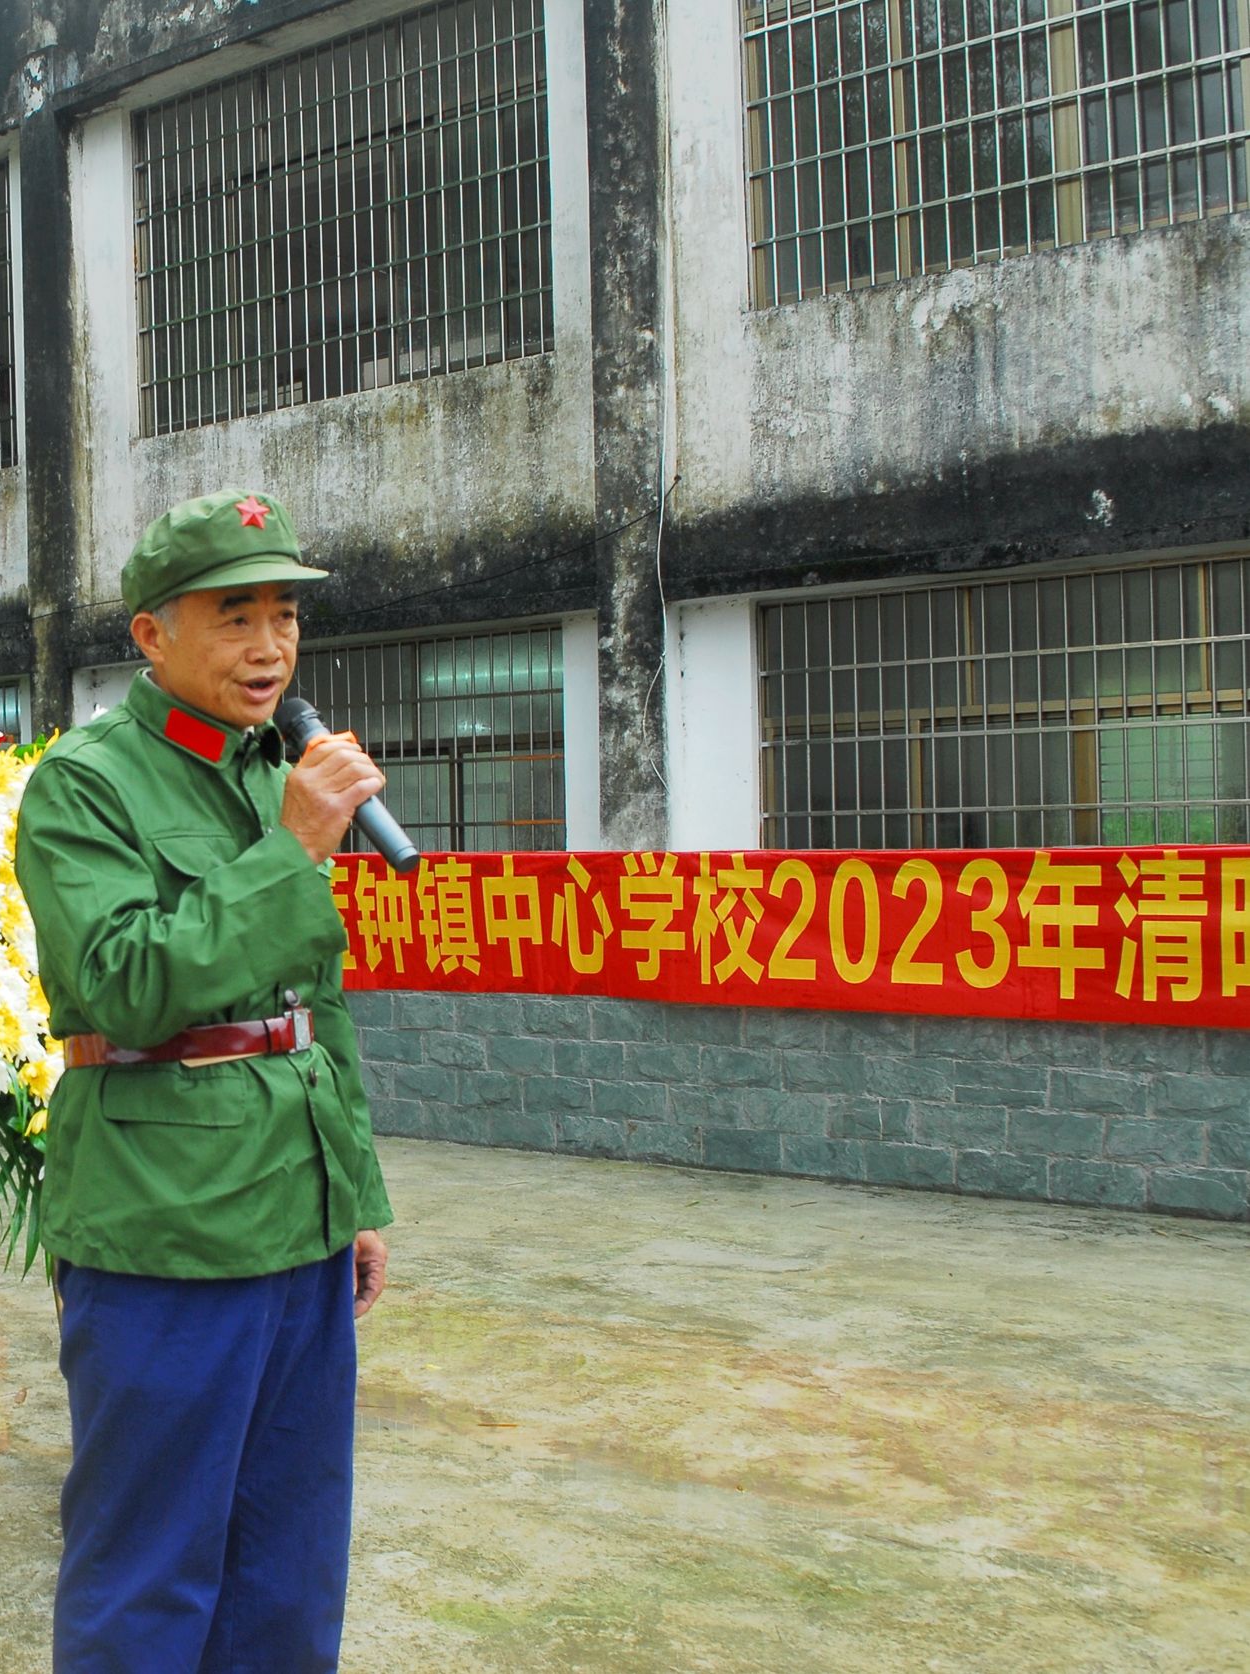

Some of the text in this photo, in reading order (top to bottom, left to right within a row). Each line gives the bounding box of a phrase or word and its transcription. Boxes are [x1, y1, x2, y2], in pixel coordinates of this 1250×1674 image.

[331, 850, 1250, 1003] 钟镇中心学校2023年清
